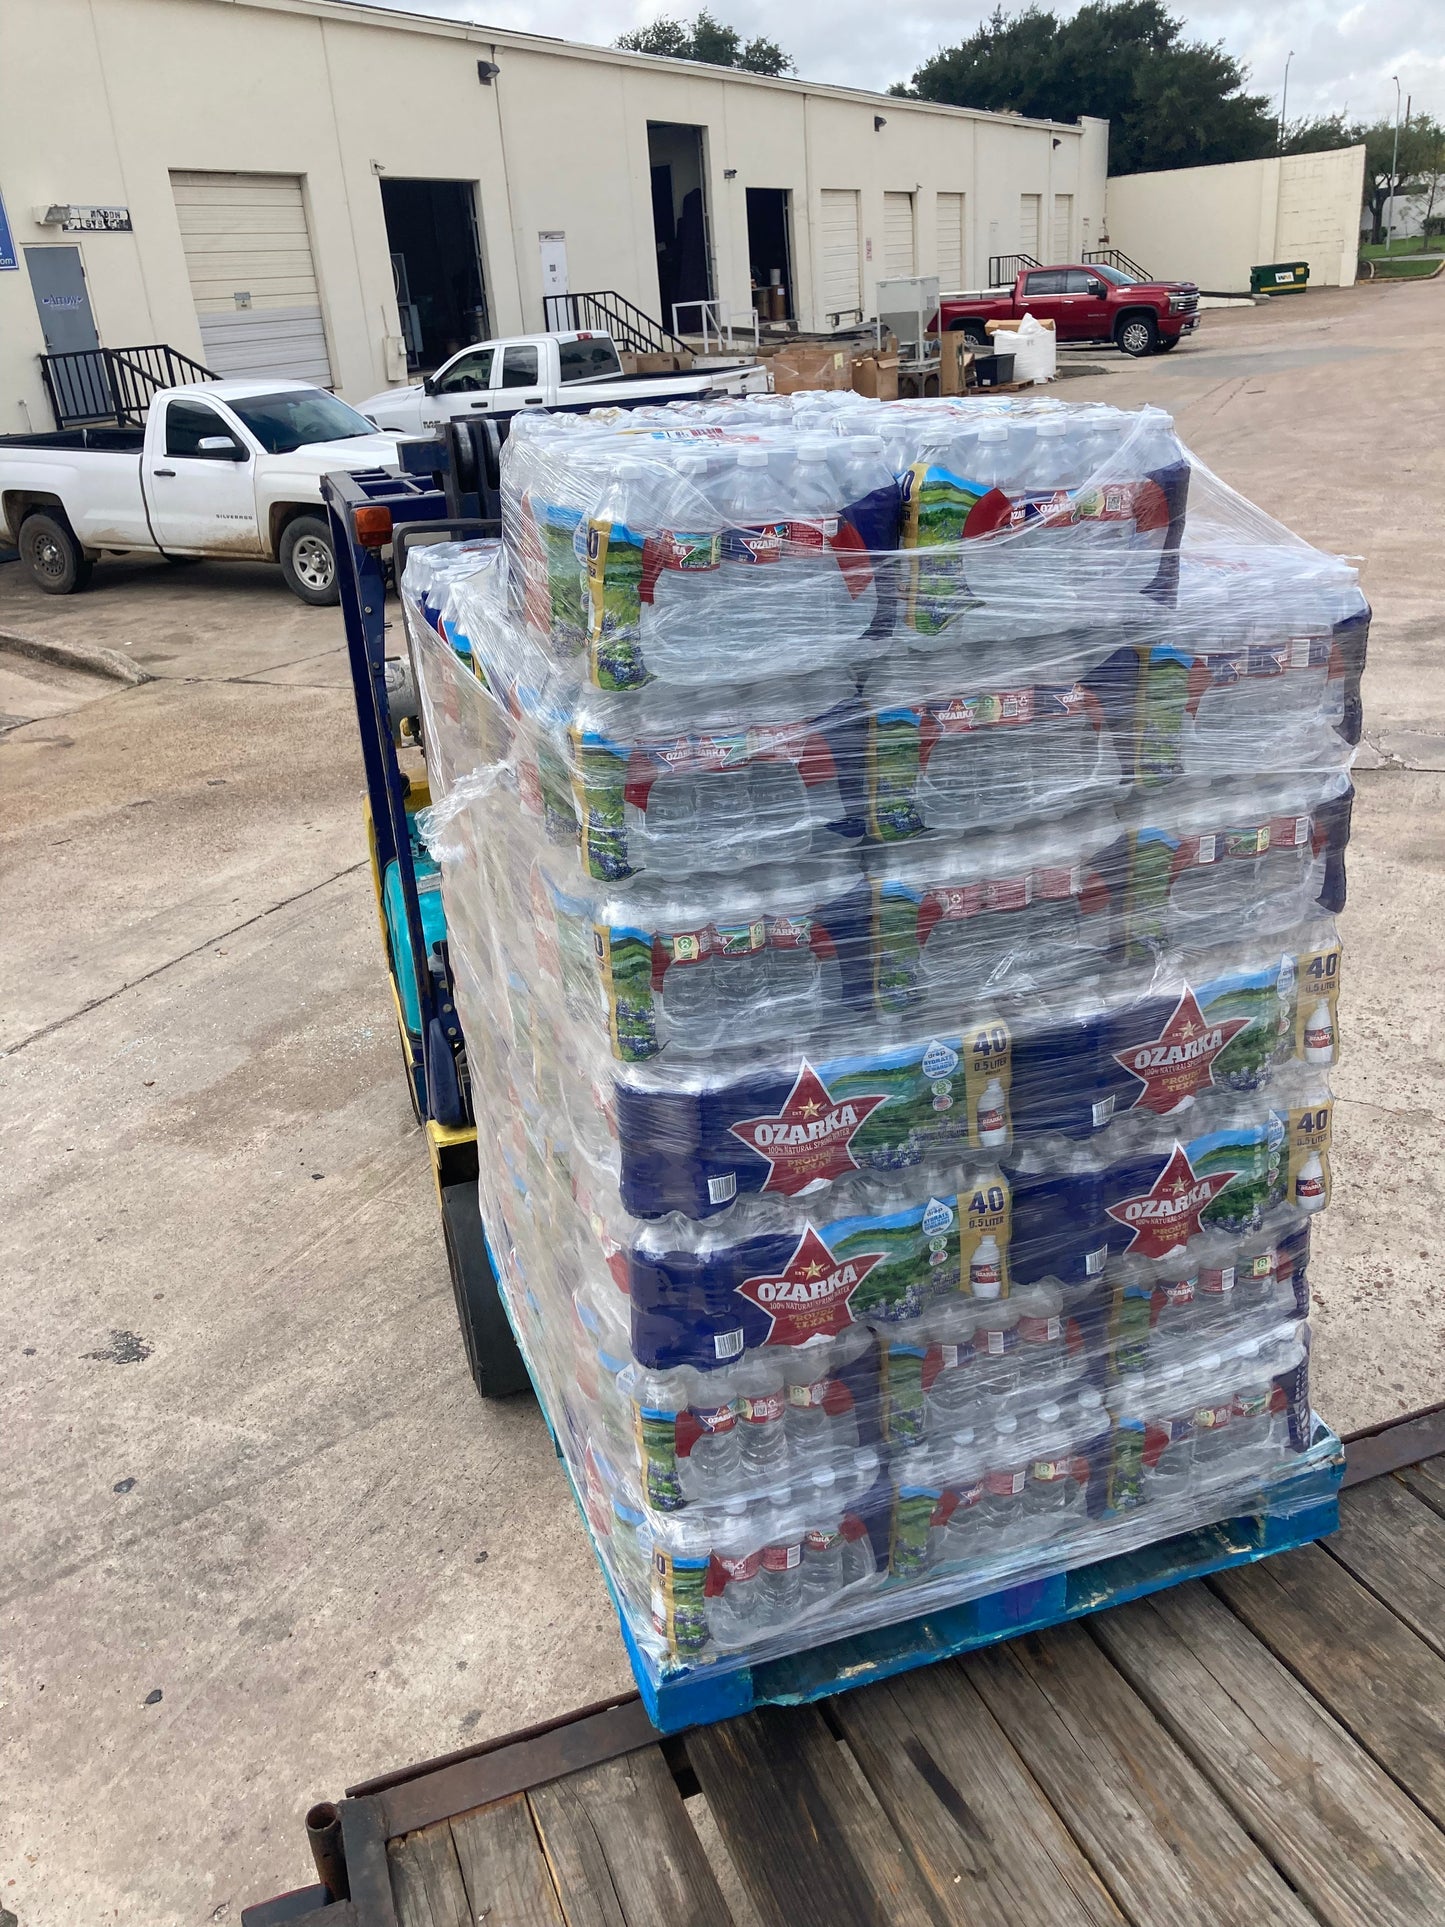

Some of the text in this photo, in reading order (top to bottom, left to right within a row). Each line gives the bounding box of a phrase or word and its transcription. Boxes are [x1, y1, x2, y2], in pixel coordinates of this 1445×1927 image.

[938, 710, 974, 722] OZARKA
[1306, 953, 1338, 979] 40
[972, 1027, 1008, 1057] 40
[1134, 1029, 1223, 1070] OZARKA
[974, 1056, 1008, 1072] 0.5 LITER
[754, 1104, 858, 1147] OZARKA
[1296, 1109, 1329, 1133] 40
[784, 1144, 814, 1156] NATURAL
[968, 1186, 1005, 1215] 40
[1125, 1181, 1213, 1220] OZARKA
[969, 1215, 1004, 1229] 0.5 LITER
[757, 1264, 858, 1302] OZARKA
[769, 1302, 785, 1310] 100%
[785, 1302, 813, 1311] NATURAL
[794, 1313, 835, 1329] TEXAN
